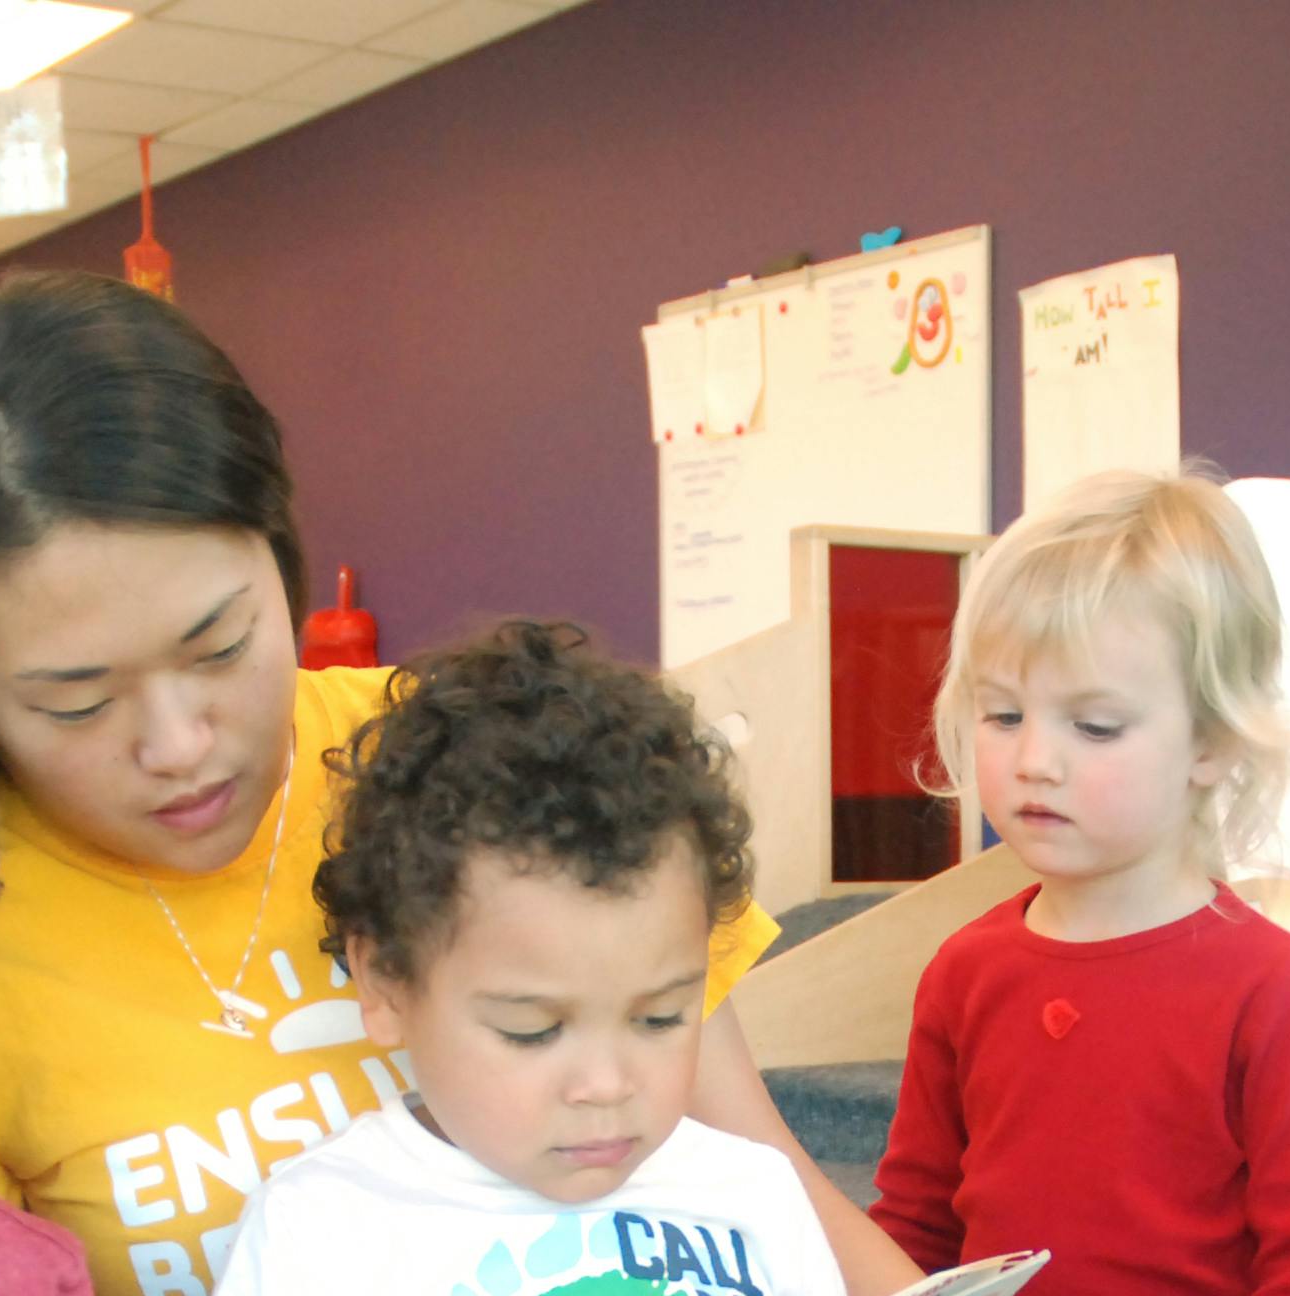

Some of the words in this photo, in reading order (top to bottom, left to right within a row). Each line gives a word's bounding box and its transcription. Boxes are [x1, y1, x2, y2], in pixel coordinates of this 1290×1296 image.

[1034, 303, 1075, 329] HOW
[1083, 282, 1128, 320] TALL
[105, 1050, 419, 1228] ENSU
